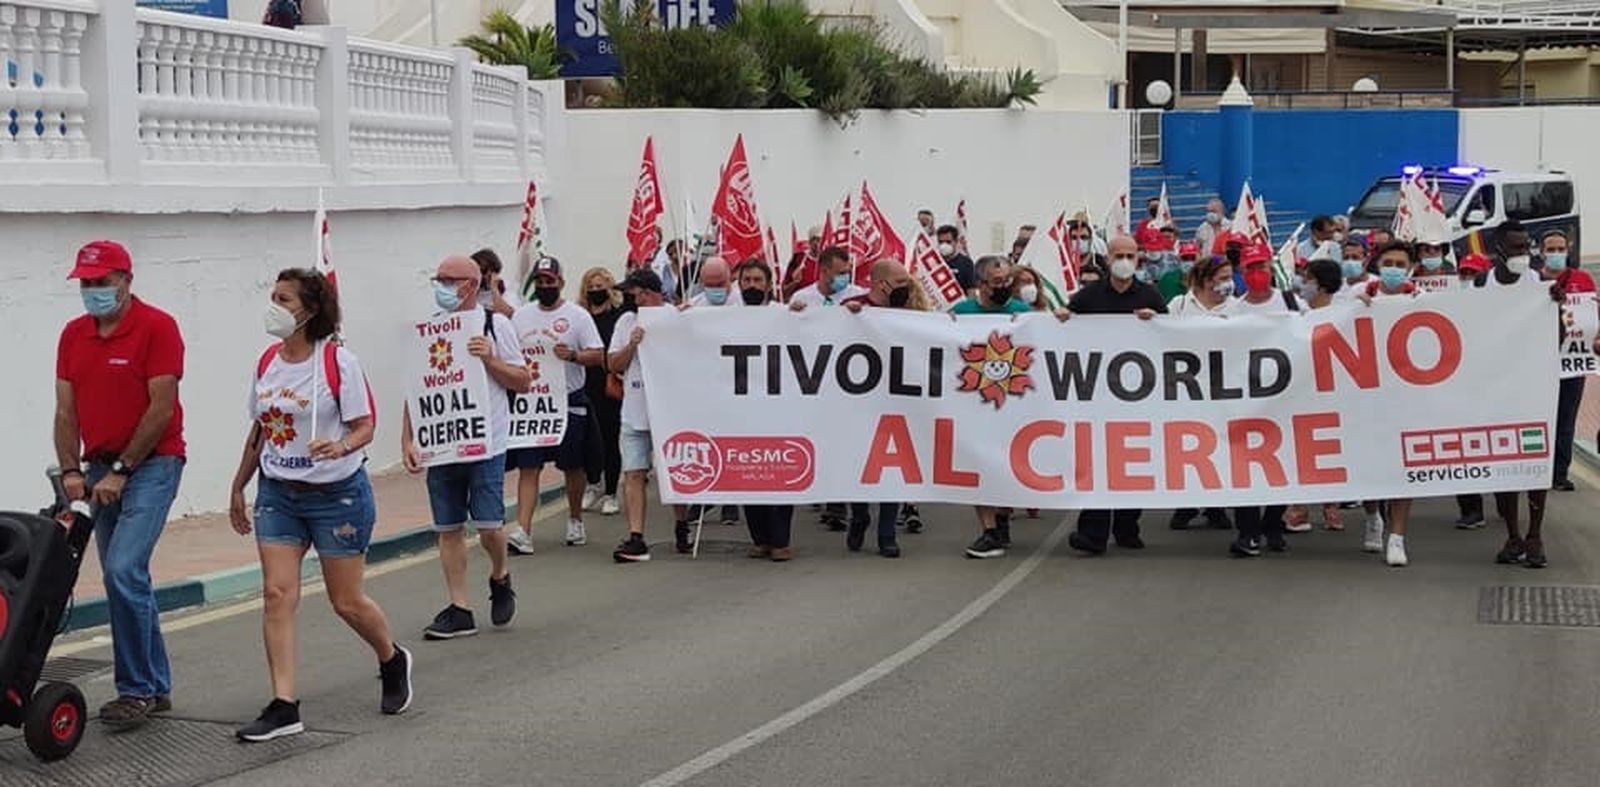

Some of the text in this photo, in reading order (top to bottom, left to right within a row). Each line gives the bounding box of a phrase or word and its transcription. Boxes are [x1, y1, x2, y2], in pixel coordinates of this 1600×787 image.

[416, 316, 462, 337] Tivoli
[720, 310, 1463, 402] TIVOLI WORLD NO
[1568, 341, 1590, 353] AL
[1561, 357, 1596, 372] RRE
[424, 369, 465, 389] World
[419, 388, 476, 418] NO AL
[535, 396, 558, 414] AL
[418, 416, 486, 448] CIERRE
[508, 418, 564, 436] IERRE
[666, 441, 713, 466] UGT
[860, 411, 1348, 493] AL CIERRE
[1403, 429, 1519, 462] CCOO
[726, 448, 797, 464] FeSMC
[1407, 463, 1492, 483] servicios
